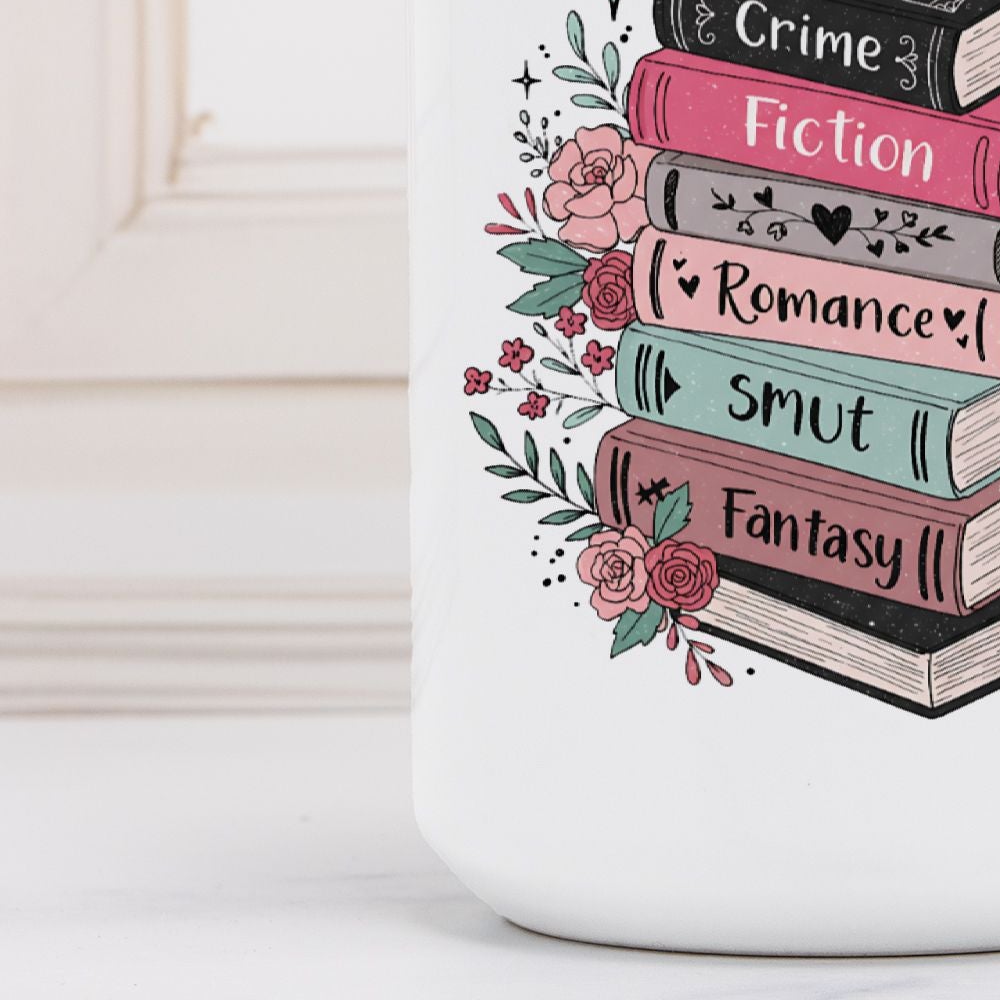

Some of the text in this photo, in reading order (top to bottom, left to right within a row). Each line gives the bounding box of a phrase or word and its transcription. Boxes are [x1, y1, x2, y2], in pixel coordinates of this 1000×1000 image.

[735, 0, 882, 71] Crime
[744, 94, 933, 182] Fiction
[713, 260, 934, 340] Romance
[721, 487, 903, 590] Fantasy
